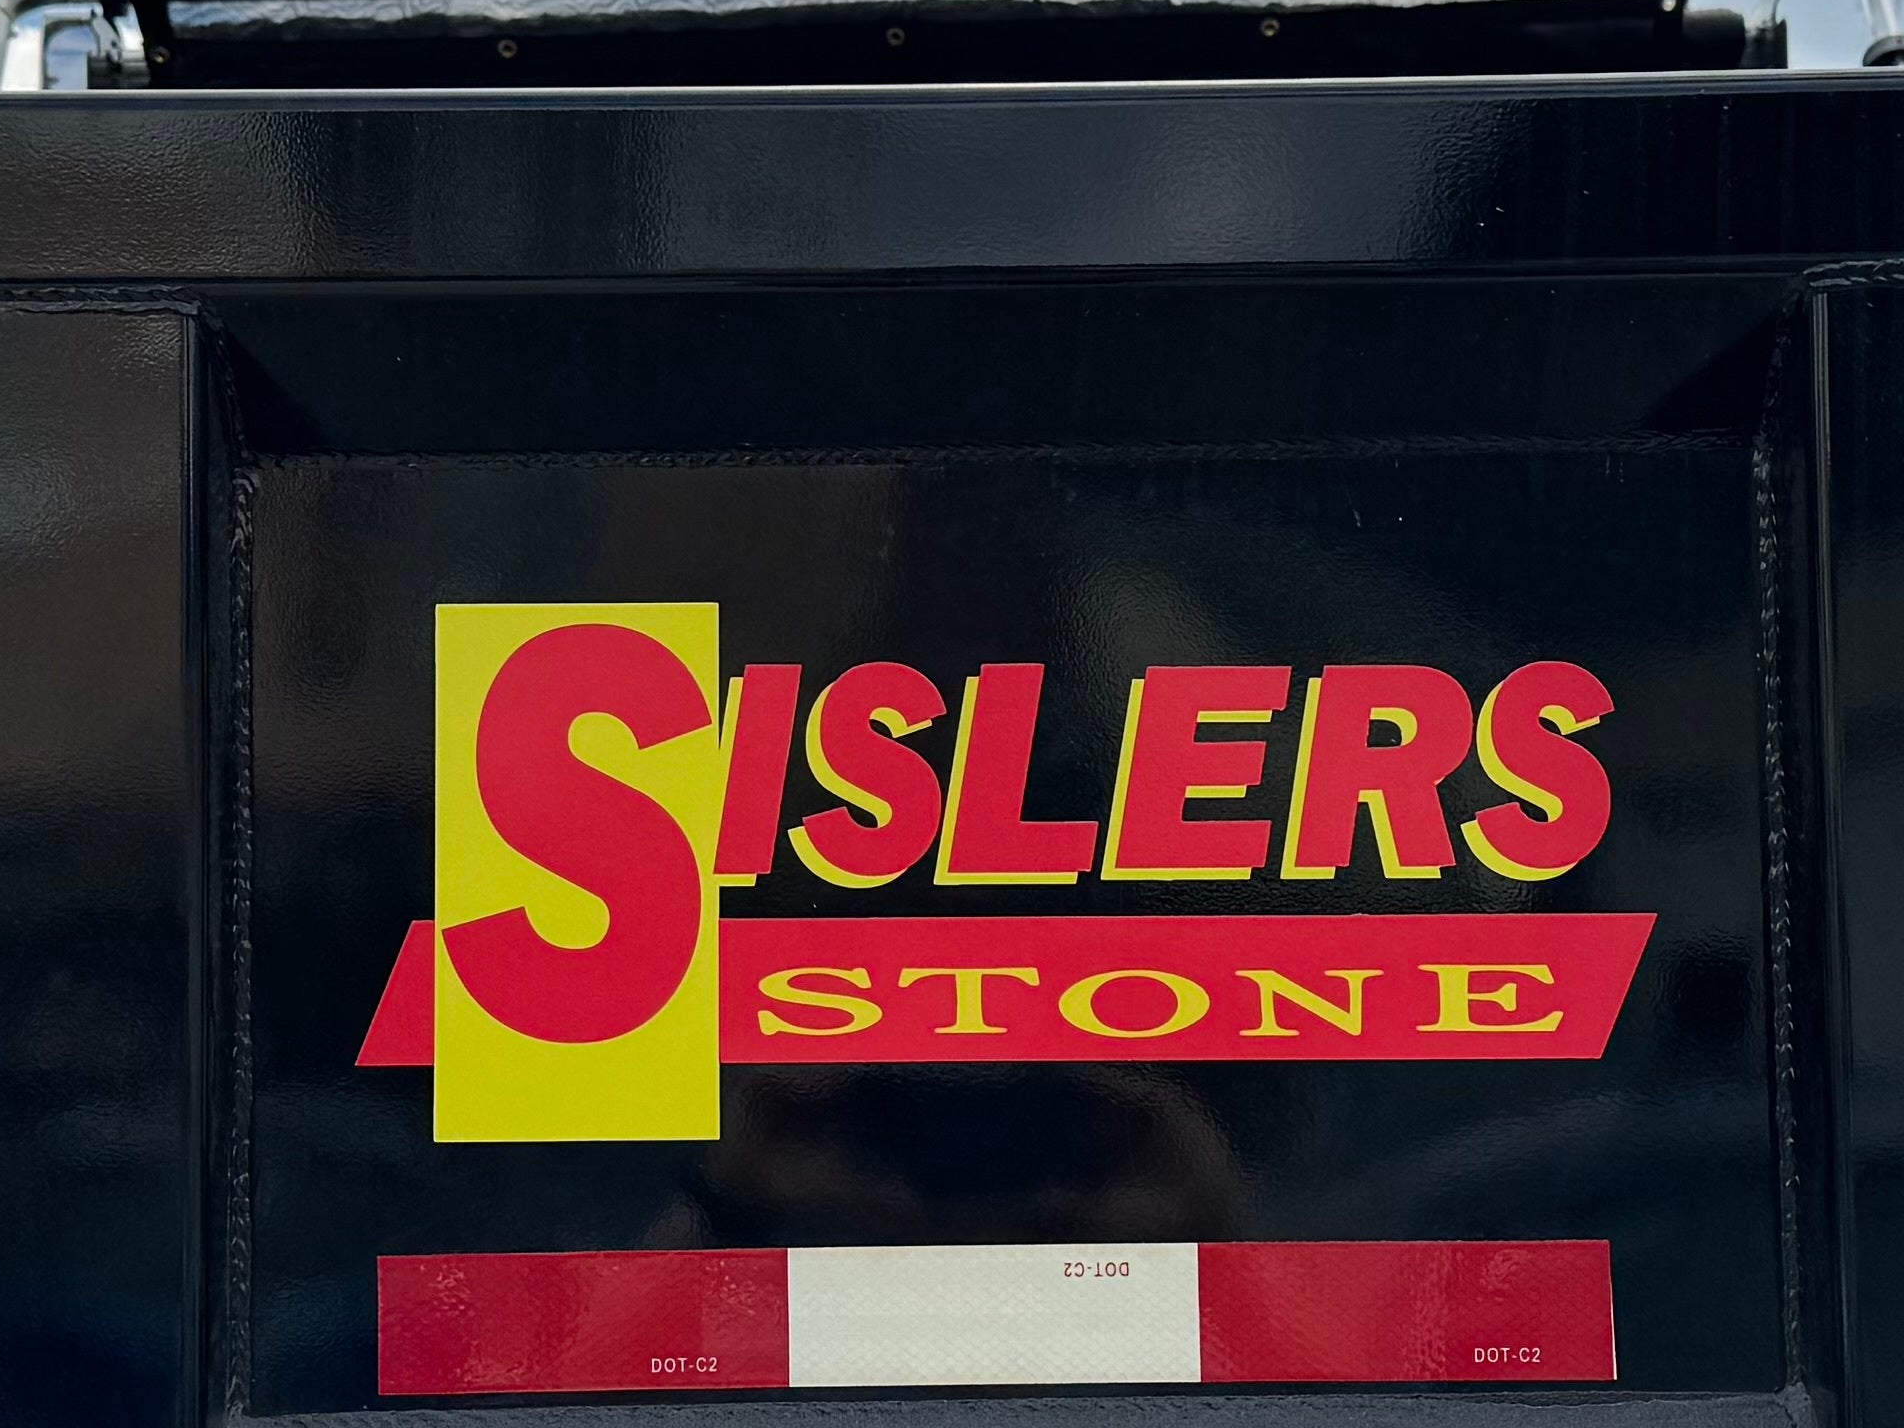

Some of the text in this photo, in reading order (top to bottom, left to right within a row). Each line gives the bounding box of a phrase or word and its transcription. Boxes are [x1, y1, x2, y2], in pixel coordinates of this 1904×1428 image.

[439, 622, 1615, 1044] SISLERS
[758, 965, 1566, 1036] STONE
[1062, 1260, 1130, 1279] DOT-C2
[649, 1354, 720, 1374] DOT-C2
[1473, 1346, 1542, 1365] DOT-C2
